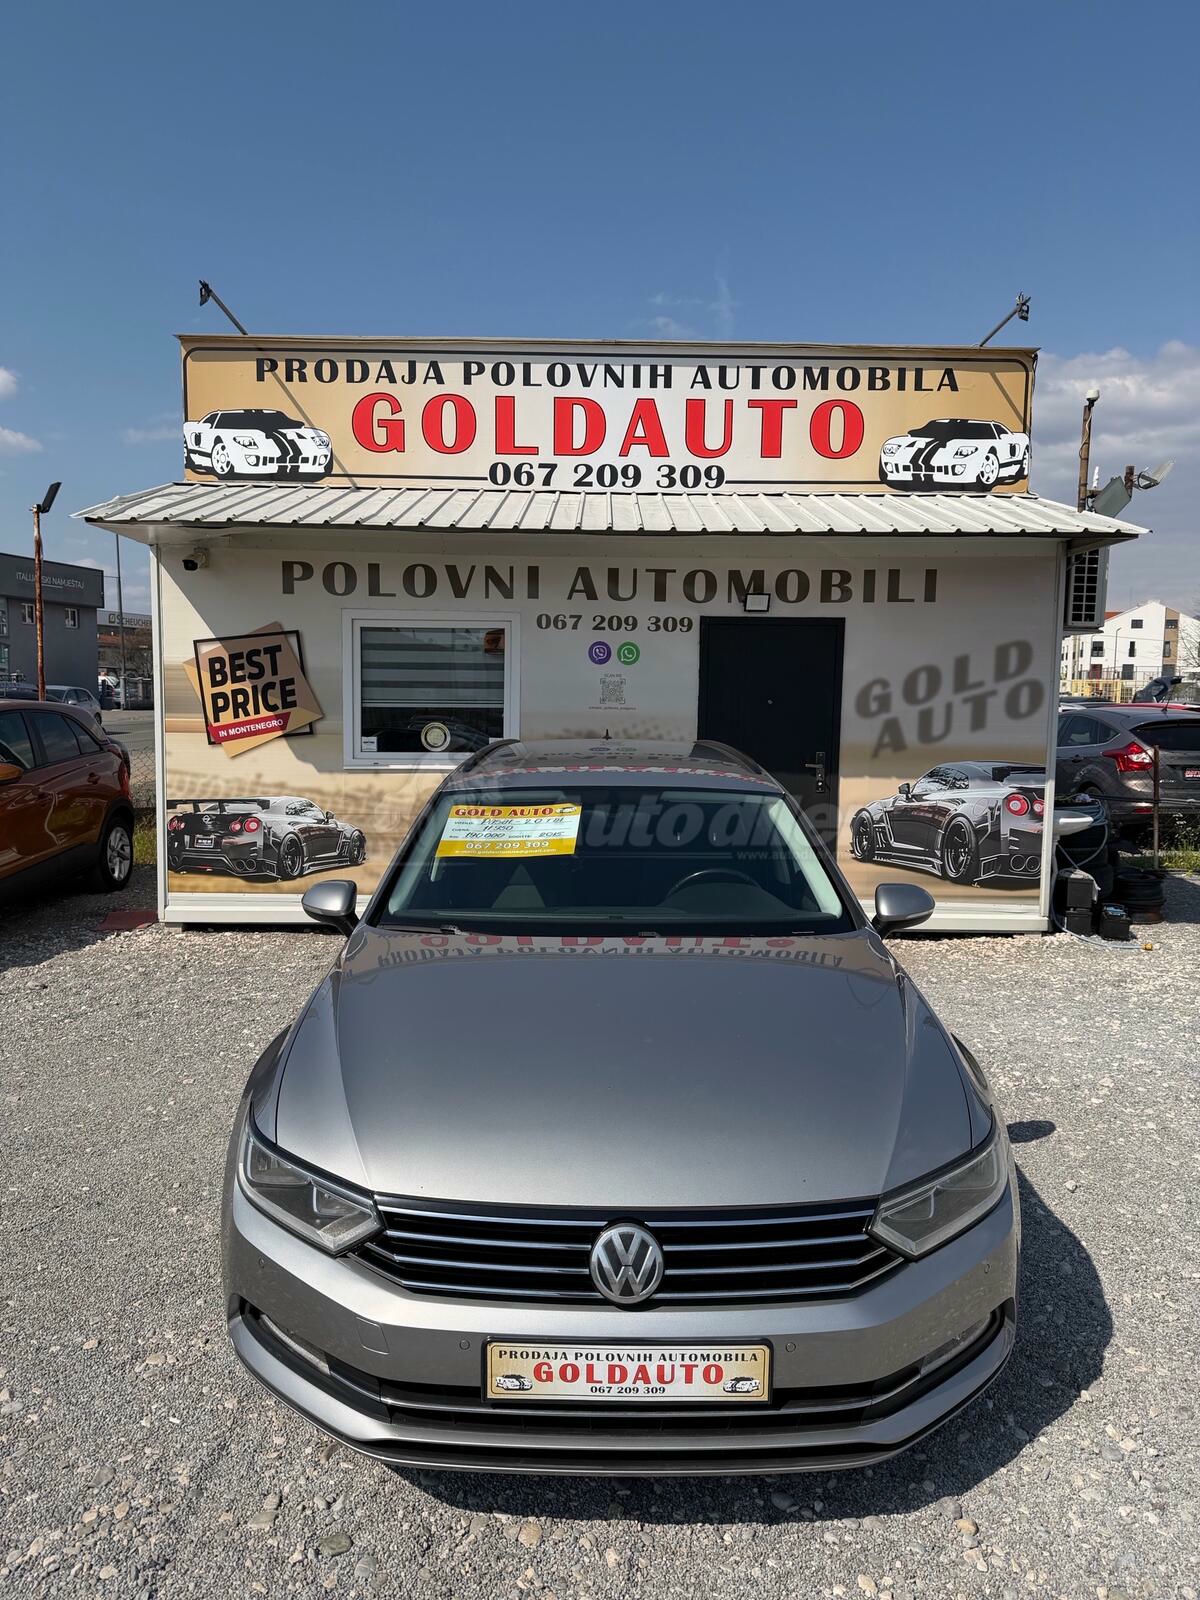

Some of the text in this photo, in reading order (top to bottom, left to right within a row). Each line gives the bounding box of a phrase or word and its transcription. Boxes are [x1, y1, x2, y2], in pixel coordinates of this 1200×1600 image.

[256, 357, 959, 392] PRODAJA POLOVNIH AUTOMOBILA
[351, 391, 865, 460] GOLDAUTO
[488, 461, 726, 490] 067 209 309
[281, 560, 938, 604] POLOVNI AUTOMOBILI
[536, 613, 694, 633] 067 209 309
[208, 644, 282, 688] BEST
[854, 640, 1034, 720] GOLD
[210, 677, 298, 724] PRICE
[219, 718, 284, 738] IN MONTENEGRO
[872, 678, 1045, 759] AUTO
[454, 807, 554, 817] GOLD AUTO
[498, 1349, 759, 1363] PRODAJA POLOVNIH AUTOMOBILA
[532, 1361, 724, 1385] GOLDAUTO
[590, 1385, 666, 1395] 067 209 309
